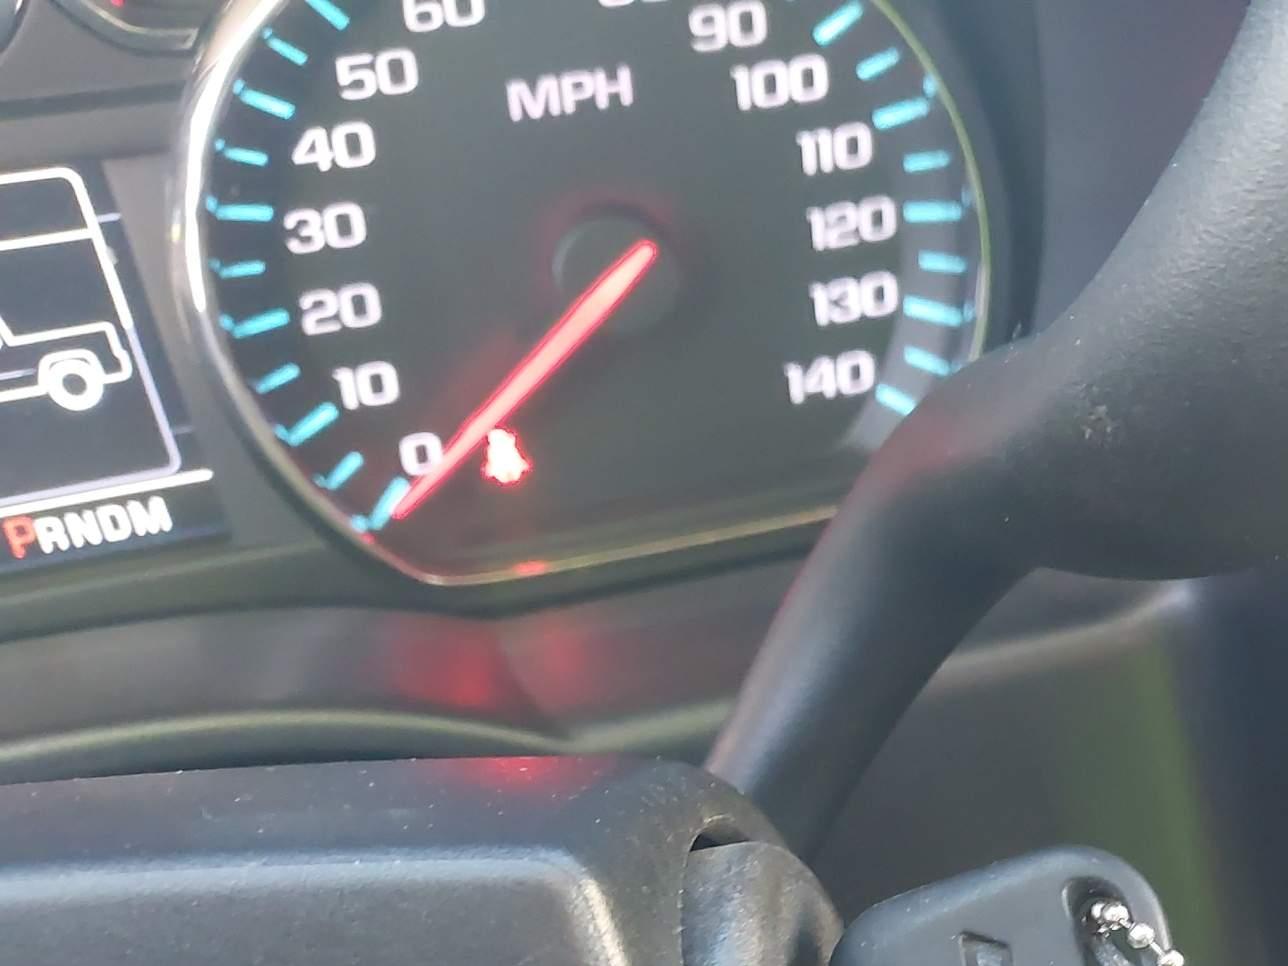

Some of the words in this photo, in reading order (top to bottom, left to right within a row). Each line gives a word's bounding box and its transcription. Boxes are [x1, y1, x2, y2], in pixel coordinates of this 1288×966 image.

[401, 0, 486, 33] 60
[688, 0, 768, 52] 90
[334, 47, 420, 101] 50
[505, 63, 635, 122] MPH
[729, 53, 830, 112] 100
[291, 120, 377, 173] 40
[796, 121, 875, 177] 110
[283, 201, 367, 255] 30
[805, 195, 898, 252] 120
[300, 282, 383, 336] 20
[809, 271, 901, 327] 130
[332, 360, 401, 411] 10
[784, 350, 876, 405] 140
[400, 431, 442, 477] 0
